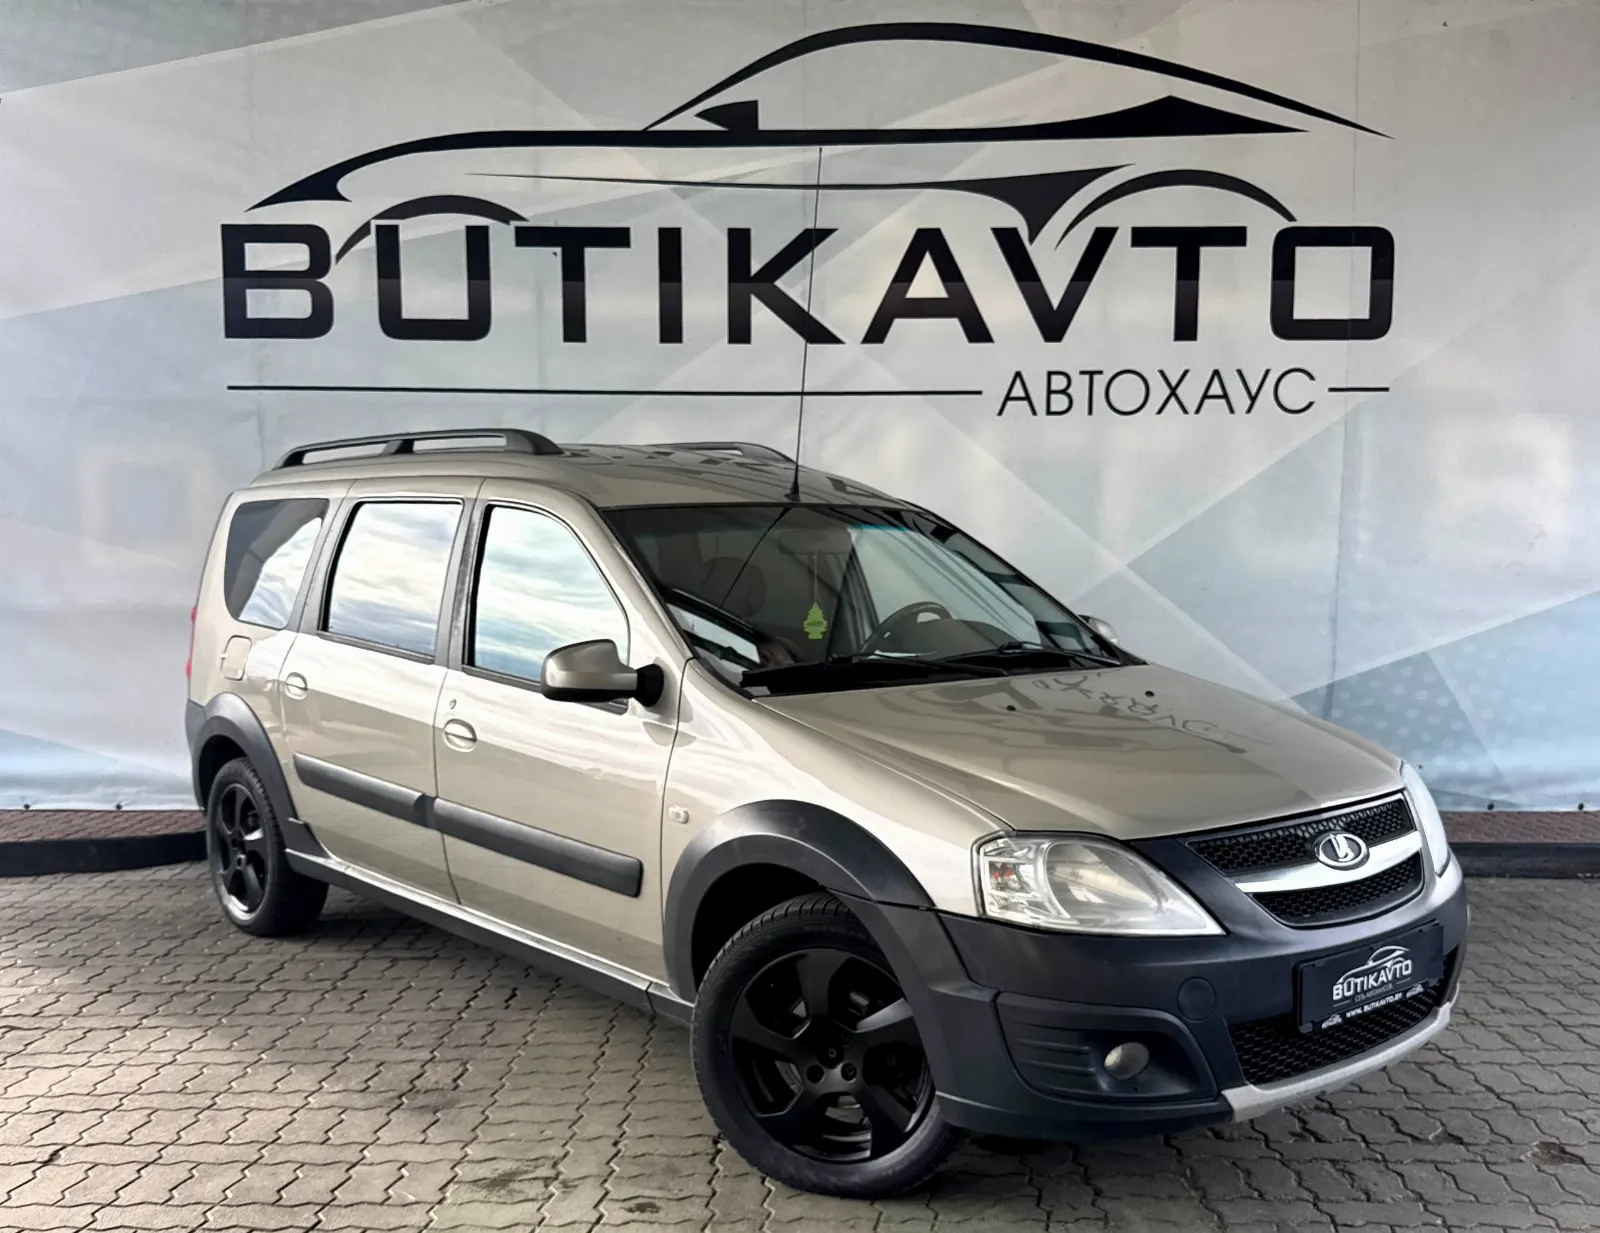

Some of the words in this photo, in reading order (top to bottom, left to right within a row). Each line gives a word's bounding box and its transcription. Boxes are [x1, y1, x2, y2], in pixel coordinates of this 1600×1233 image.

[221, 224, 1395, 345] BUTIKAVTO
[997, 367, 1316, 417] АВТОХАУС
[1332, 959, 1412, 1001] BUTIKAVTO
